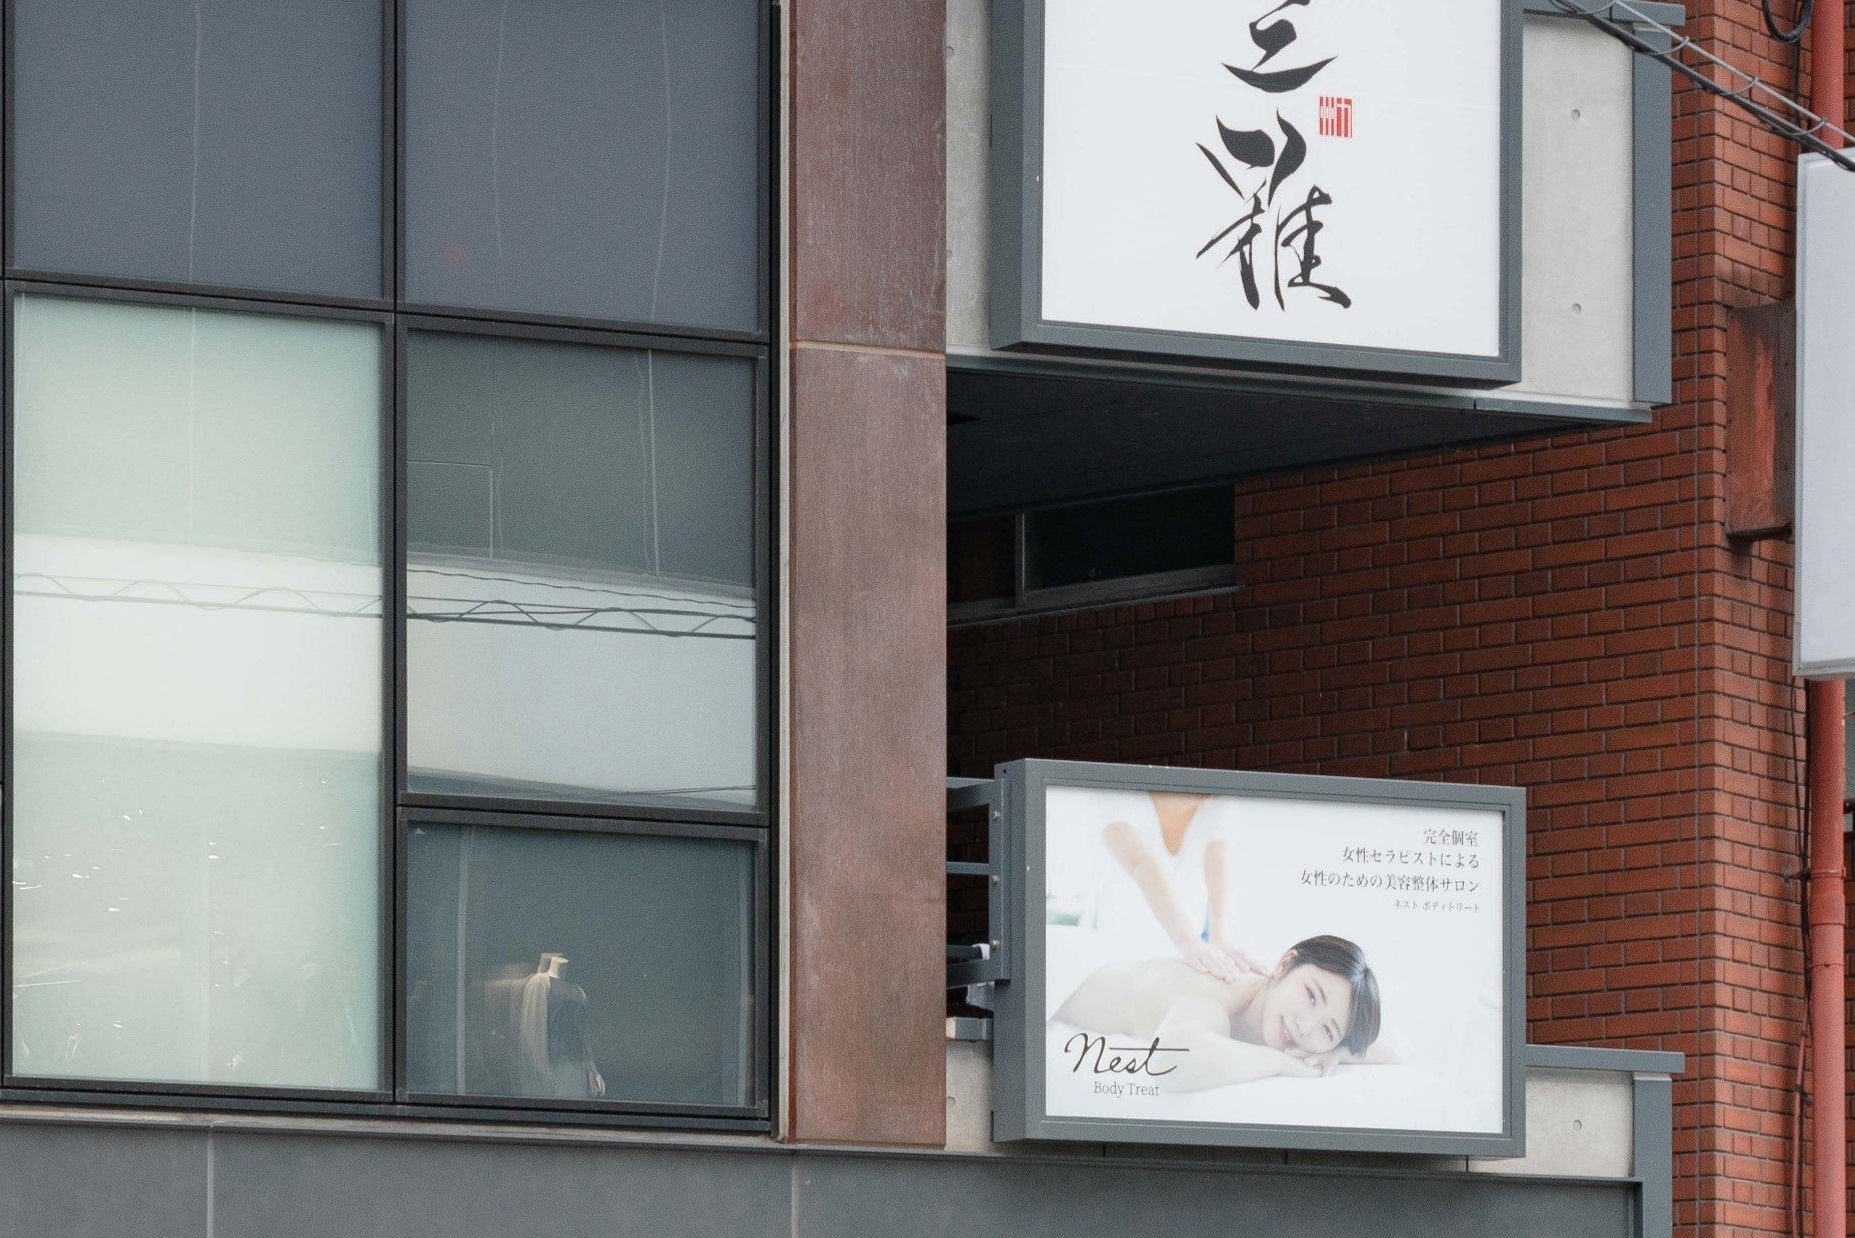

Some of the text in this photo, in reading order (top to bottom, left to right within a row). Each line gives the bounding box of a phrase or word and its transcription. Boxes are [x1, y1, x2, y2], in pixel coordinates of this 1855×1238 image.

[1423, 828, 1479, 847] 完全個室
[1342, 847, 1479, 869] 女性セラピストによる
[1300, 870, 1480, 892] 女性のための美容整体サロン
[1064, 1032, 1190, 1076] Nest
[1094, 1081, 1160, 1098] Body Treat
